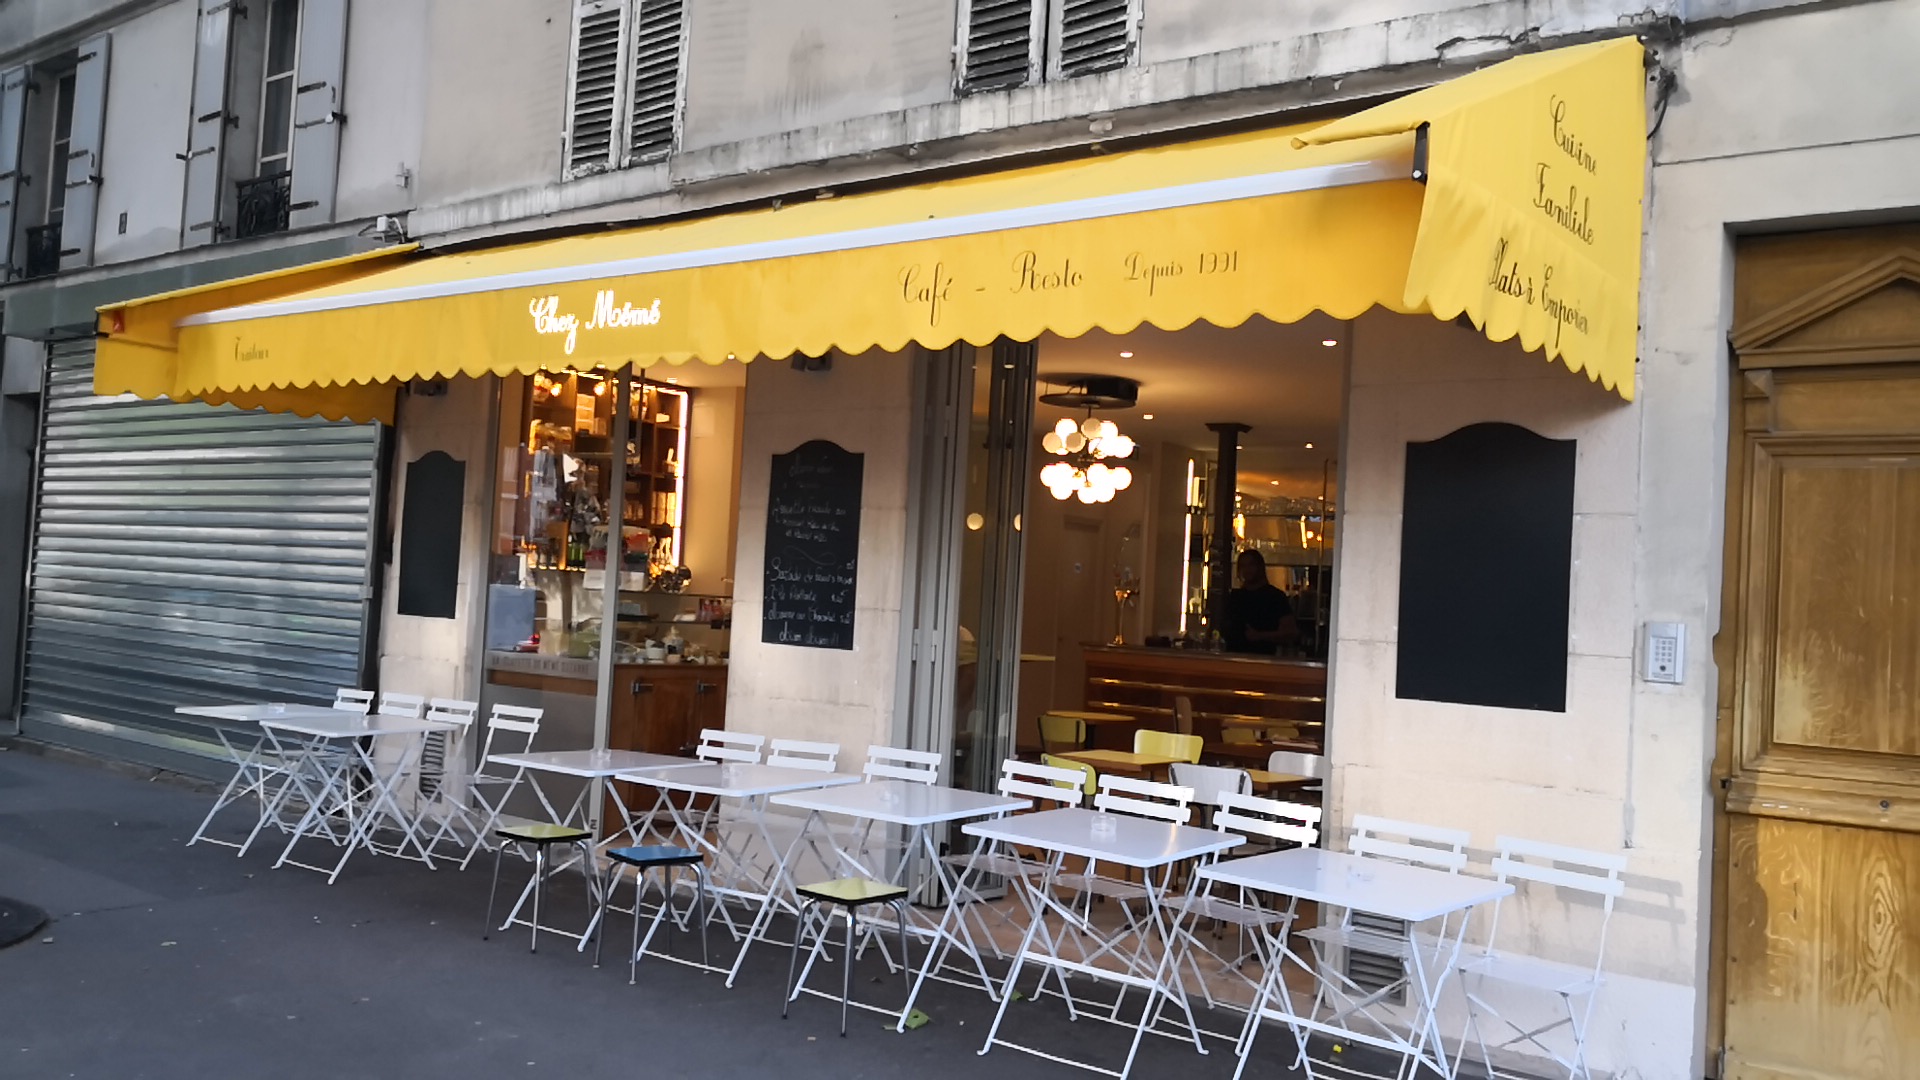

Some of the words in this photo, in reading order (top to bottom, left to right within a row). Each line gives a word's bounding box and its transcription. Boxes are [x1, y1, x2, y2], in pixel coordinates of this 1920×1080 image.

[1550, 94, 1597, 176] Cuisine
[899, 262, 953, 328] Café
[1010, 250, 1083, 294] Resto
[1124, 251, 1183, 297] Depuis
[1199, 250, 1238, 274] 1991
[1489, 237, 1525, 298] Plats
[1527, 277, 1536, 305] à
[529, 295, 579, 355] Chez
[585, 288, 661, 330] Mémé
